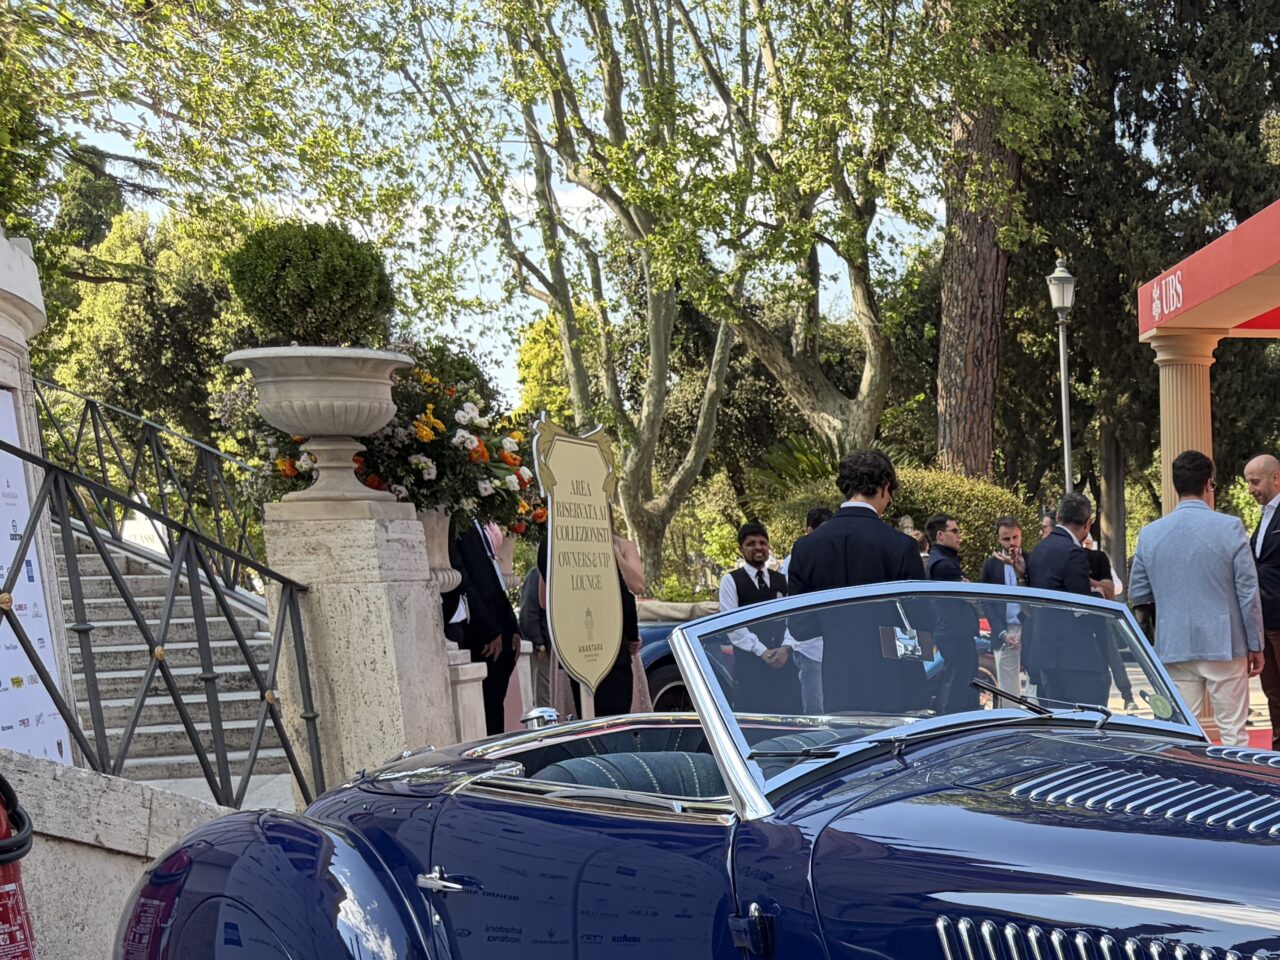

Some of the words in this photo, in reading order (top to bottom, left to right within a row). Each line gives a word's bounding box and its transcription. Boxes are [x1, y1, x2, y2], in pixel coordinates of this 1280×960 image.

[1161, 269, 1183, 313] UBS
[570, 480, 592, 497] AREA
[556, 502, 598, 520] RISERVATA
[598, 506, 607, 521] AI
[556, 527, 610, 544] COLLEZIONISTI
[571, 574, 603, 591] LOUNGE
